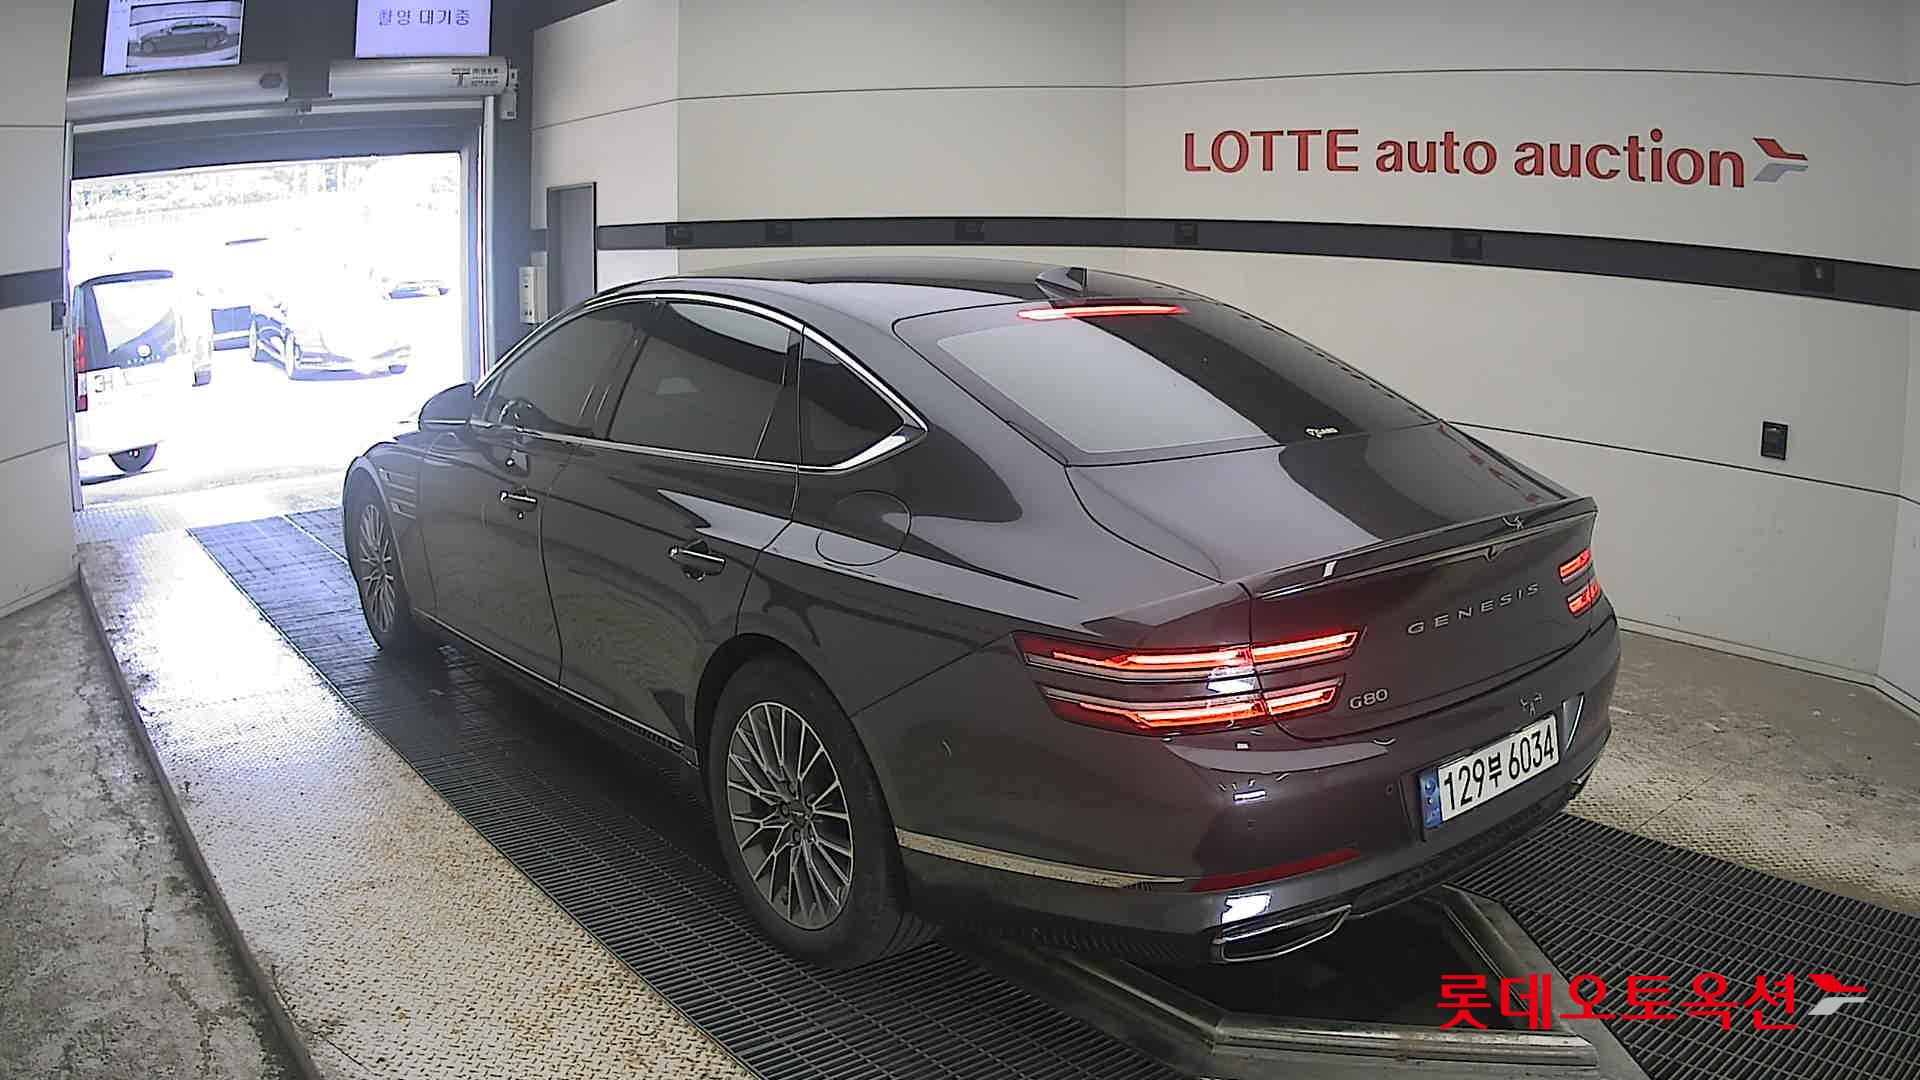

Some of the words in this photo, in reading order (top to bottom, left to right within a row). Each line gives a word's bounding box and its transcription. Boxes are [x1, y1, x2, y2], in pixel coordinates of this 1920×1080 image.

[419, 8, 471, 26] 대기중
[1184, 128, 1360, 173] LOTTE
[1375, 130, 1497, 175] auto
[1513, 128, 1745, 188] auction
[1407, 582, 1540, 635] GENESIS
[1349, 688, 1389, 710] G80
[1443, 751, 1503, 811] 129부
[1508, 724, 1554, 780] 6034
